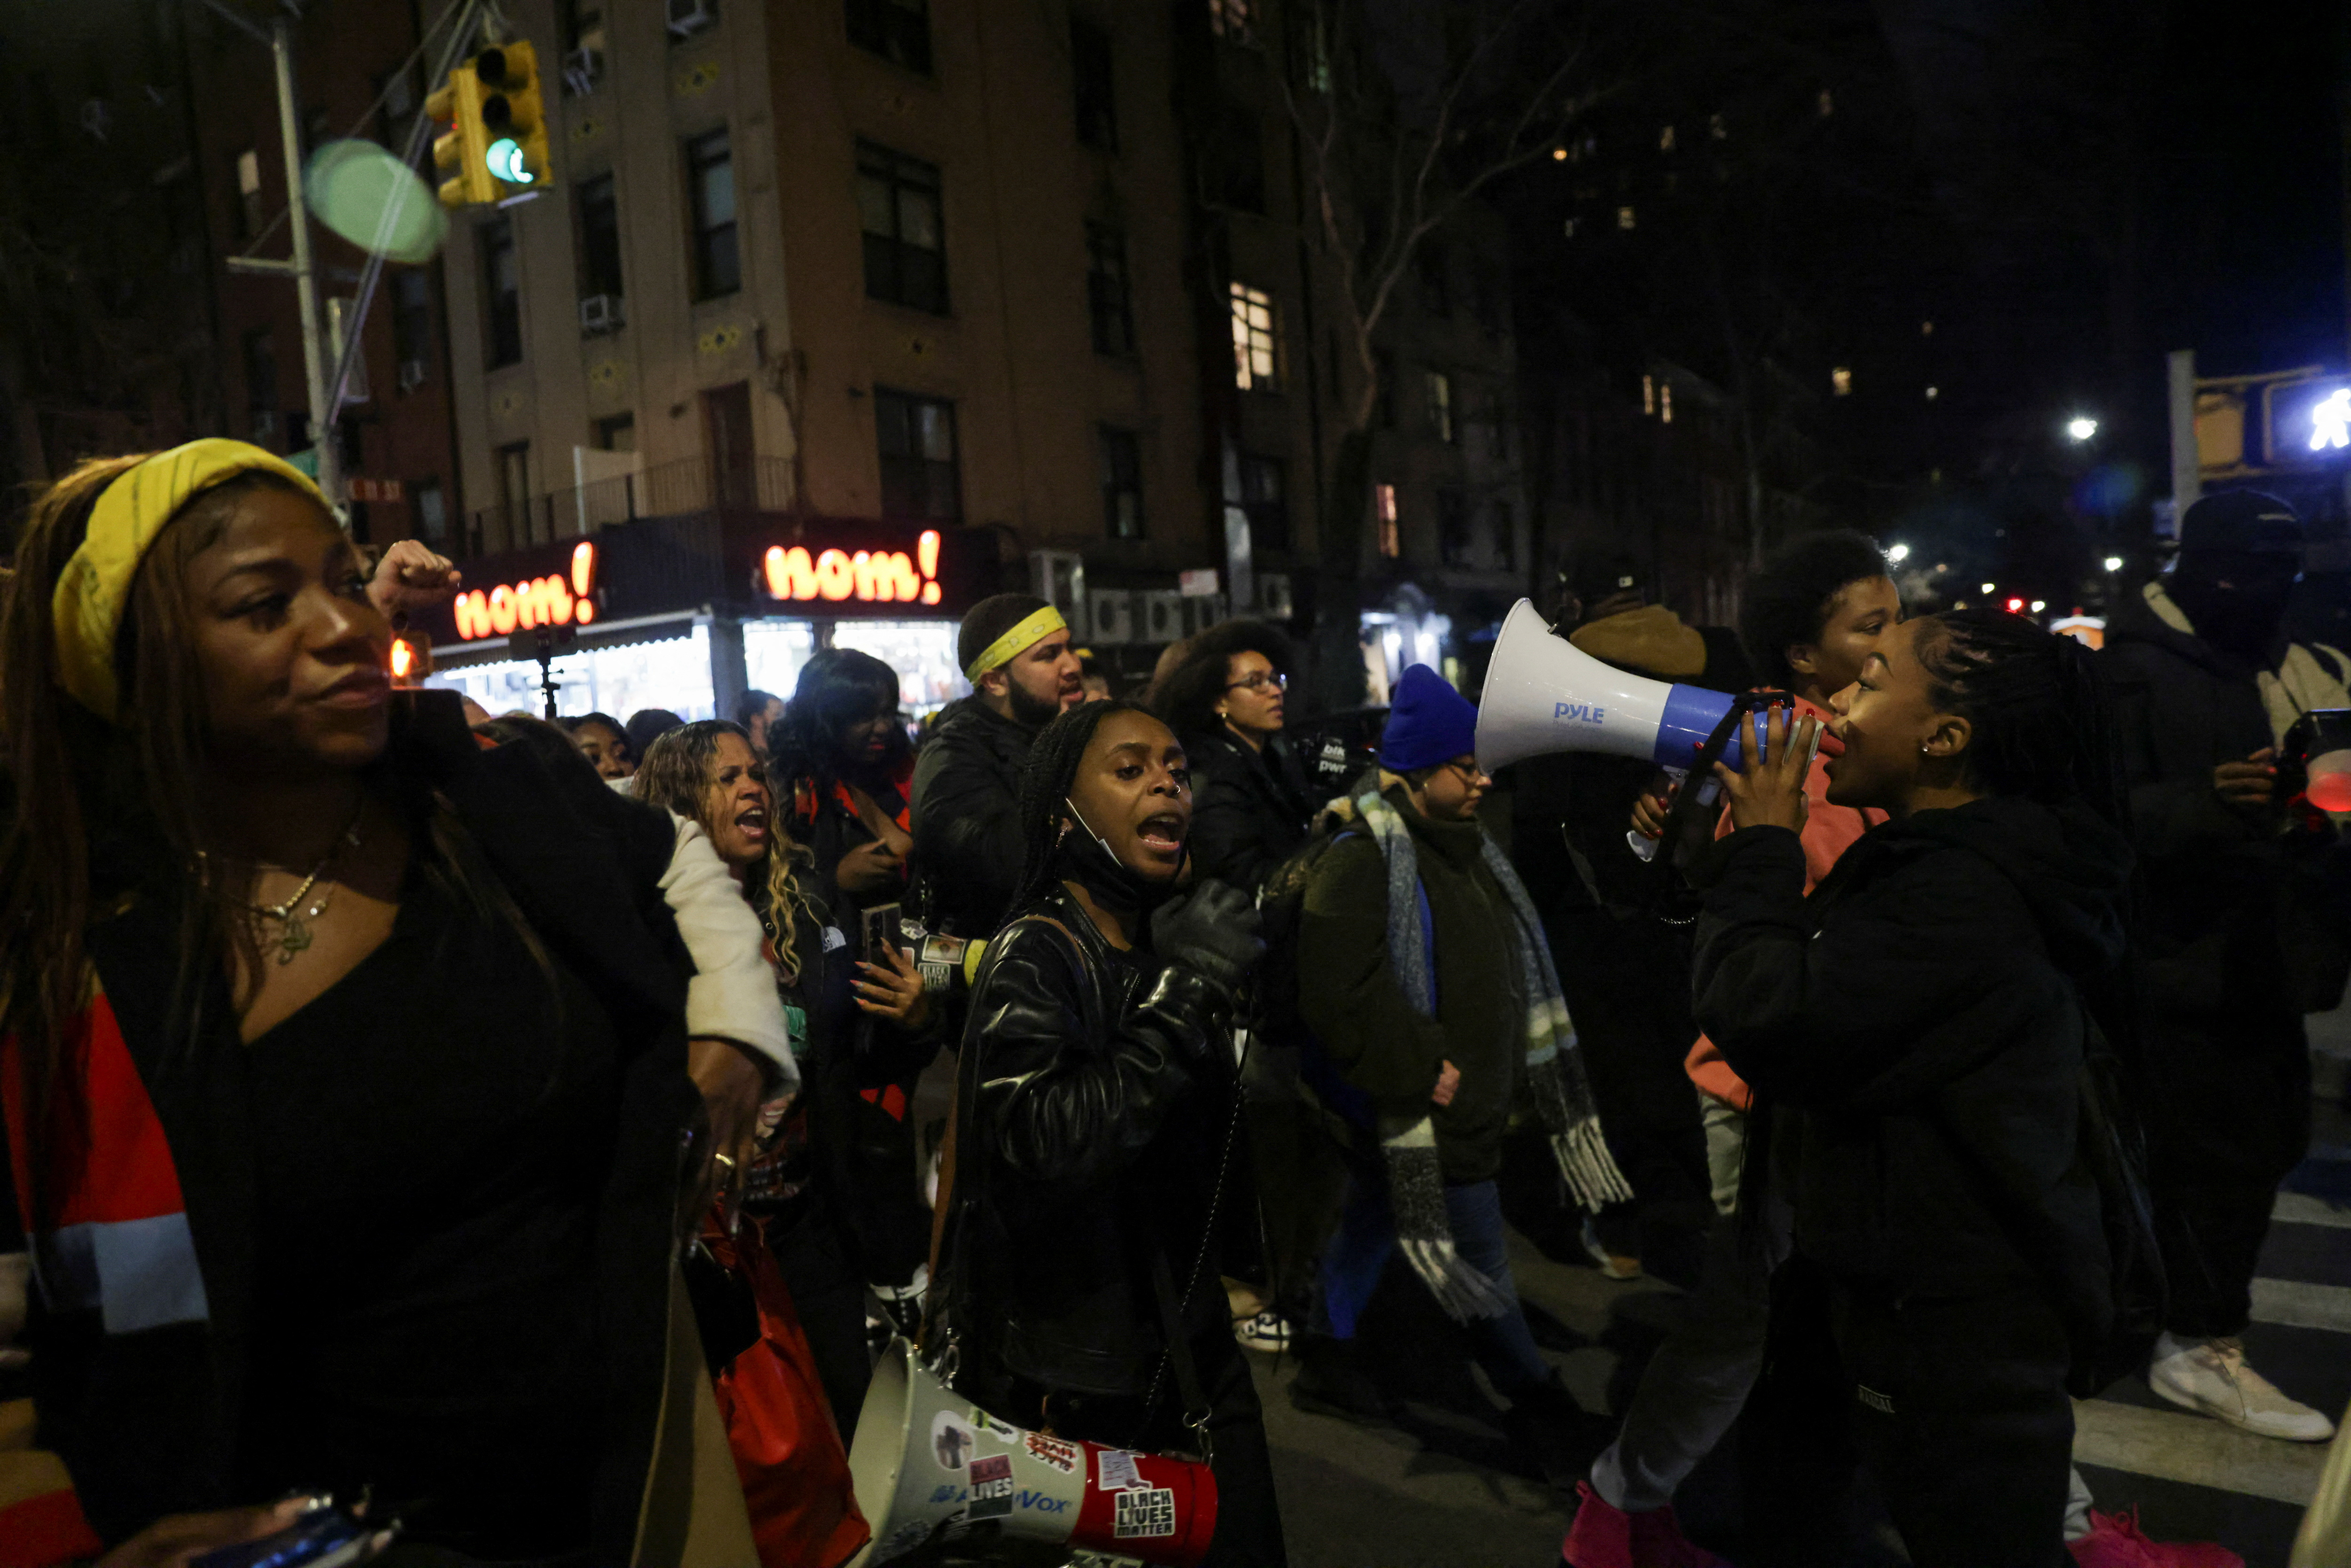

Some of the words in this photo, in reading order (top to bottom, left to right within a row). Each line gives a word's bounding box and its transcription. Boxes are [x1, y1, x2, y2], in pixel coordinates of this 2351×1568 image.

[765, 530, 941, 605] nom!
[454, 542, 593, 640] nom!
[970, 1477, 1013, 1501] LIVES
[1119, 1490, 1171, 1509] BLACK
[1119, 1506, 1172, 1525] LIVES
[1118, 1523, 1172, 1536] MATTER
